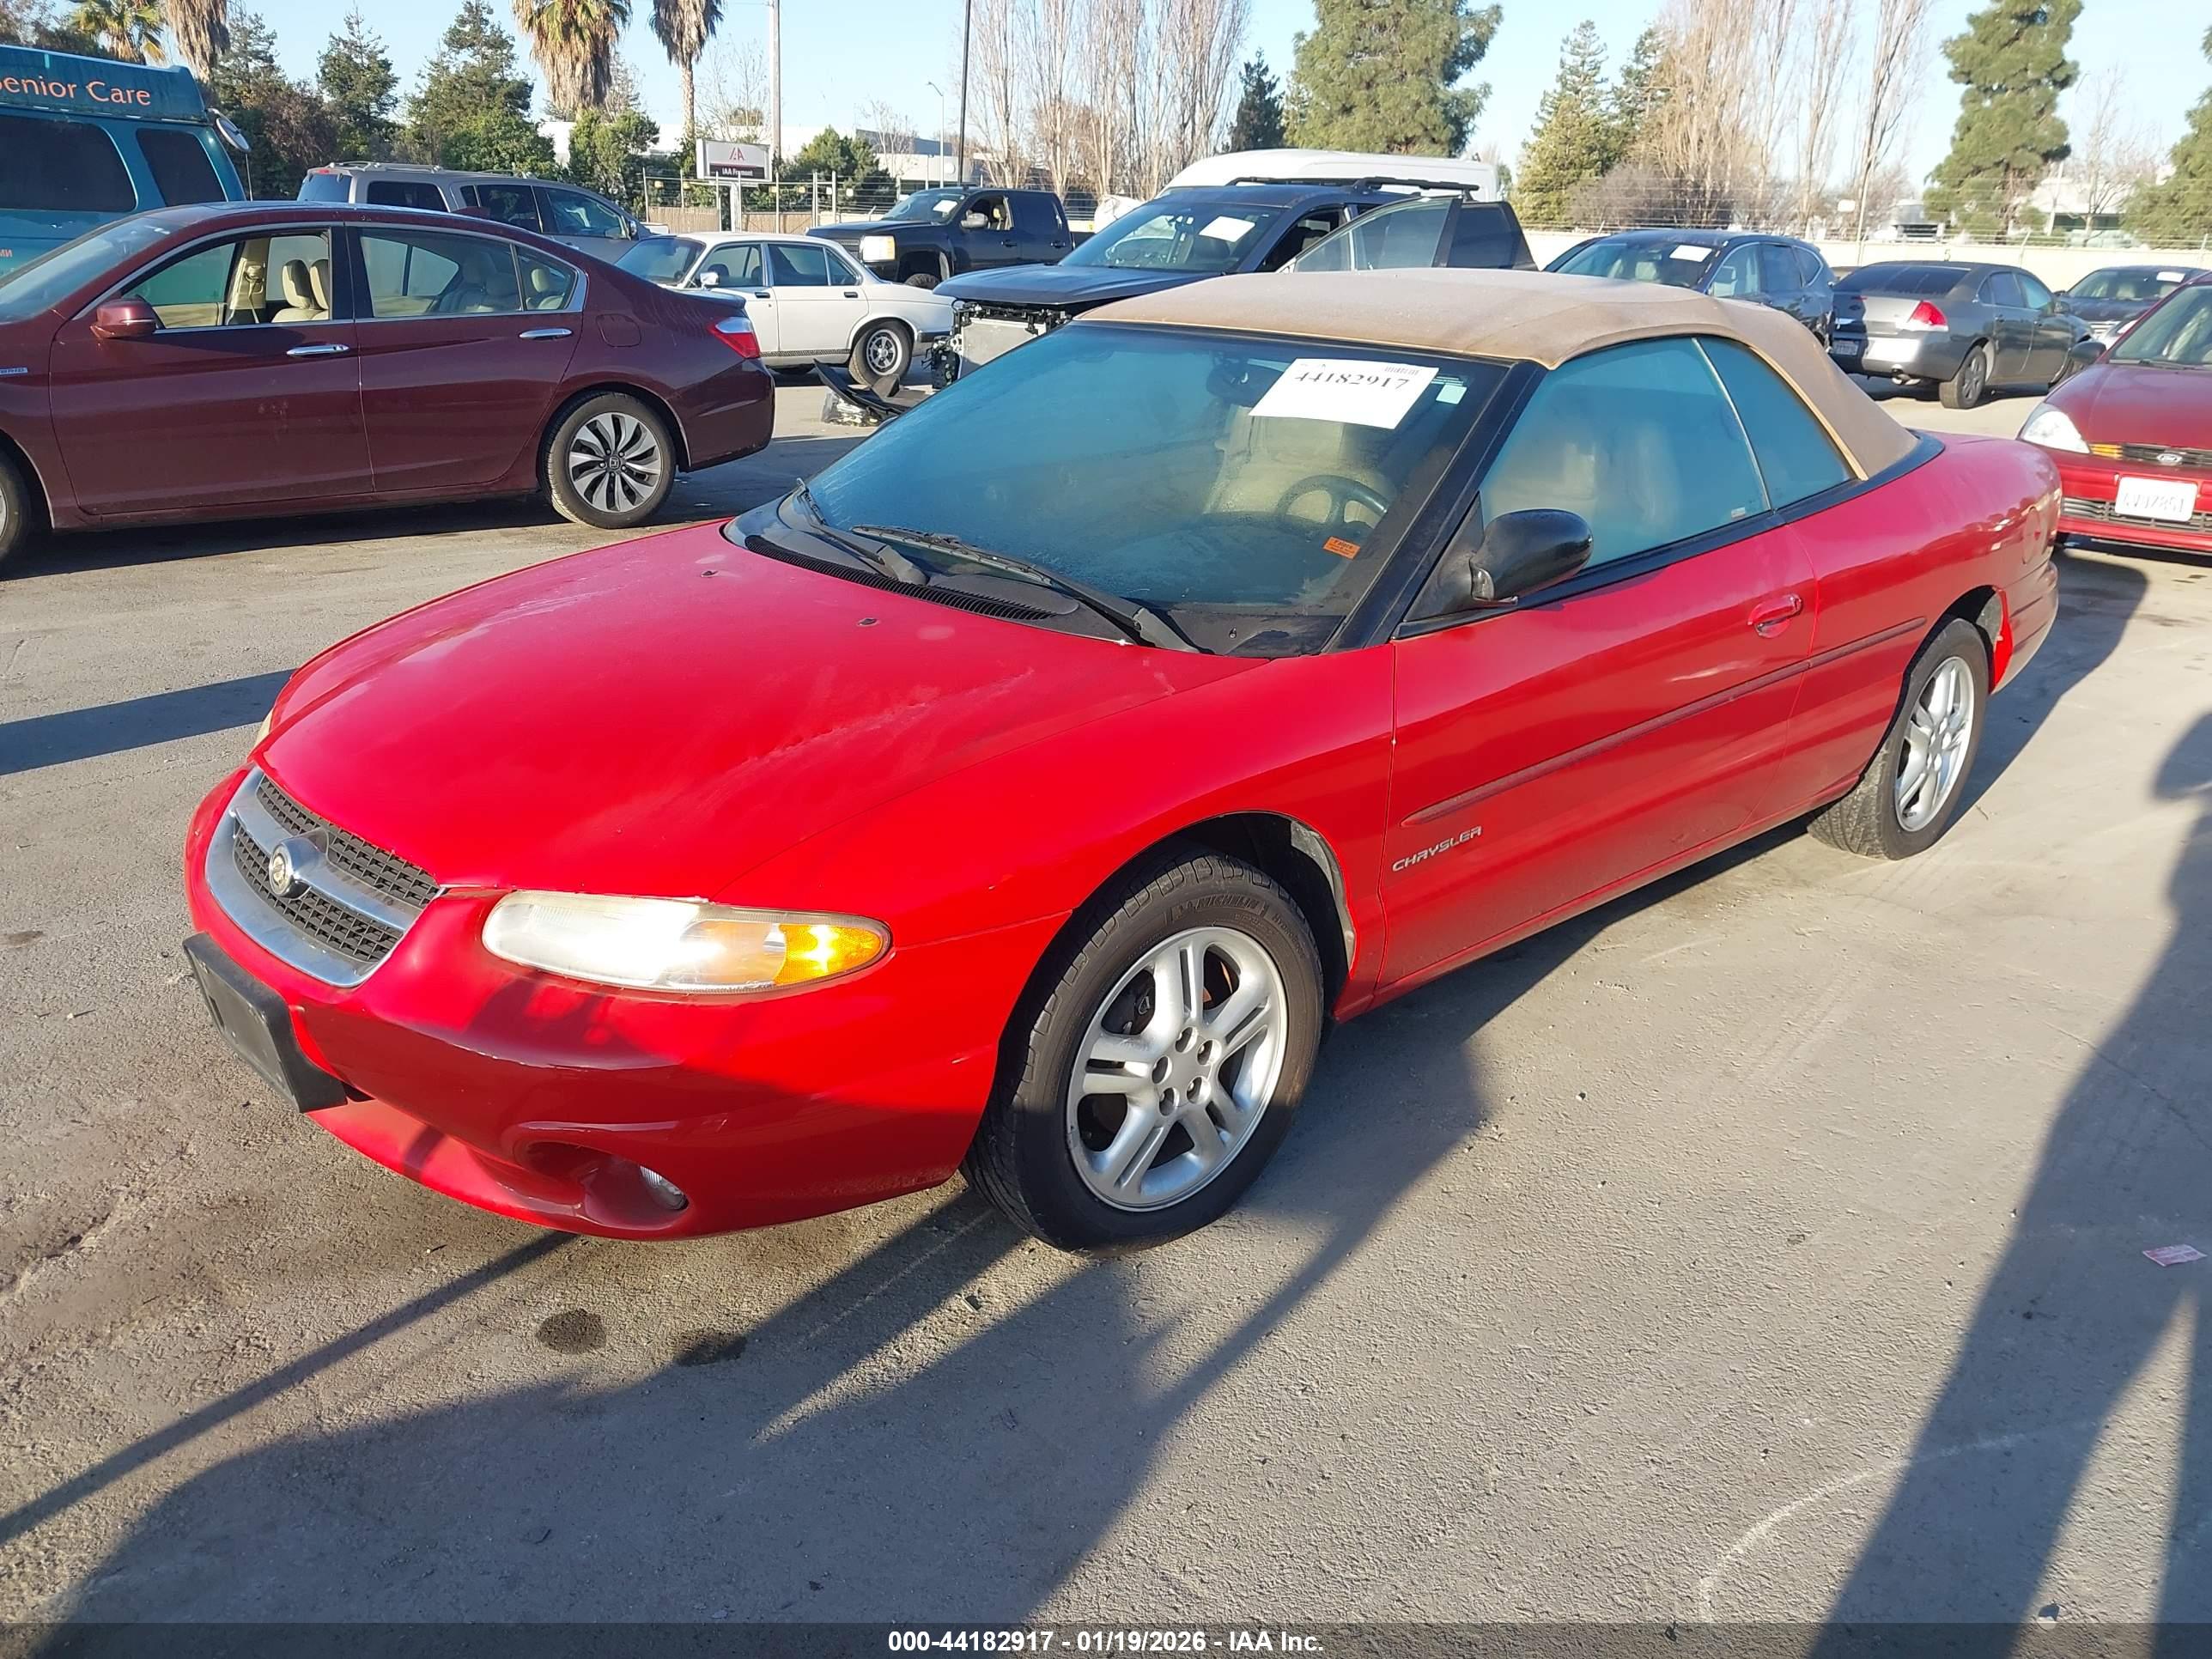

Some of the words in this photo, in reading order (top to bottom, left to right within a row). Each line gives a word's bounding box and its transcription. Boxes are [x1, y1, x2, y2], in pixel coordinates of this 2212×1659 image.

[87, 81, 151, 106] Care
[722, 167, 732, 176] IAA
[1294, 371, 1410, 390] 44182917
[1392, 825, 1482, 872] CHRYSLER
